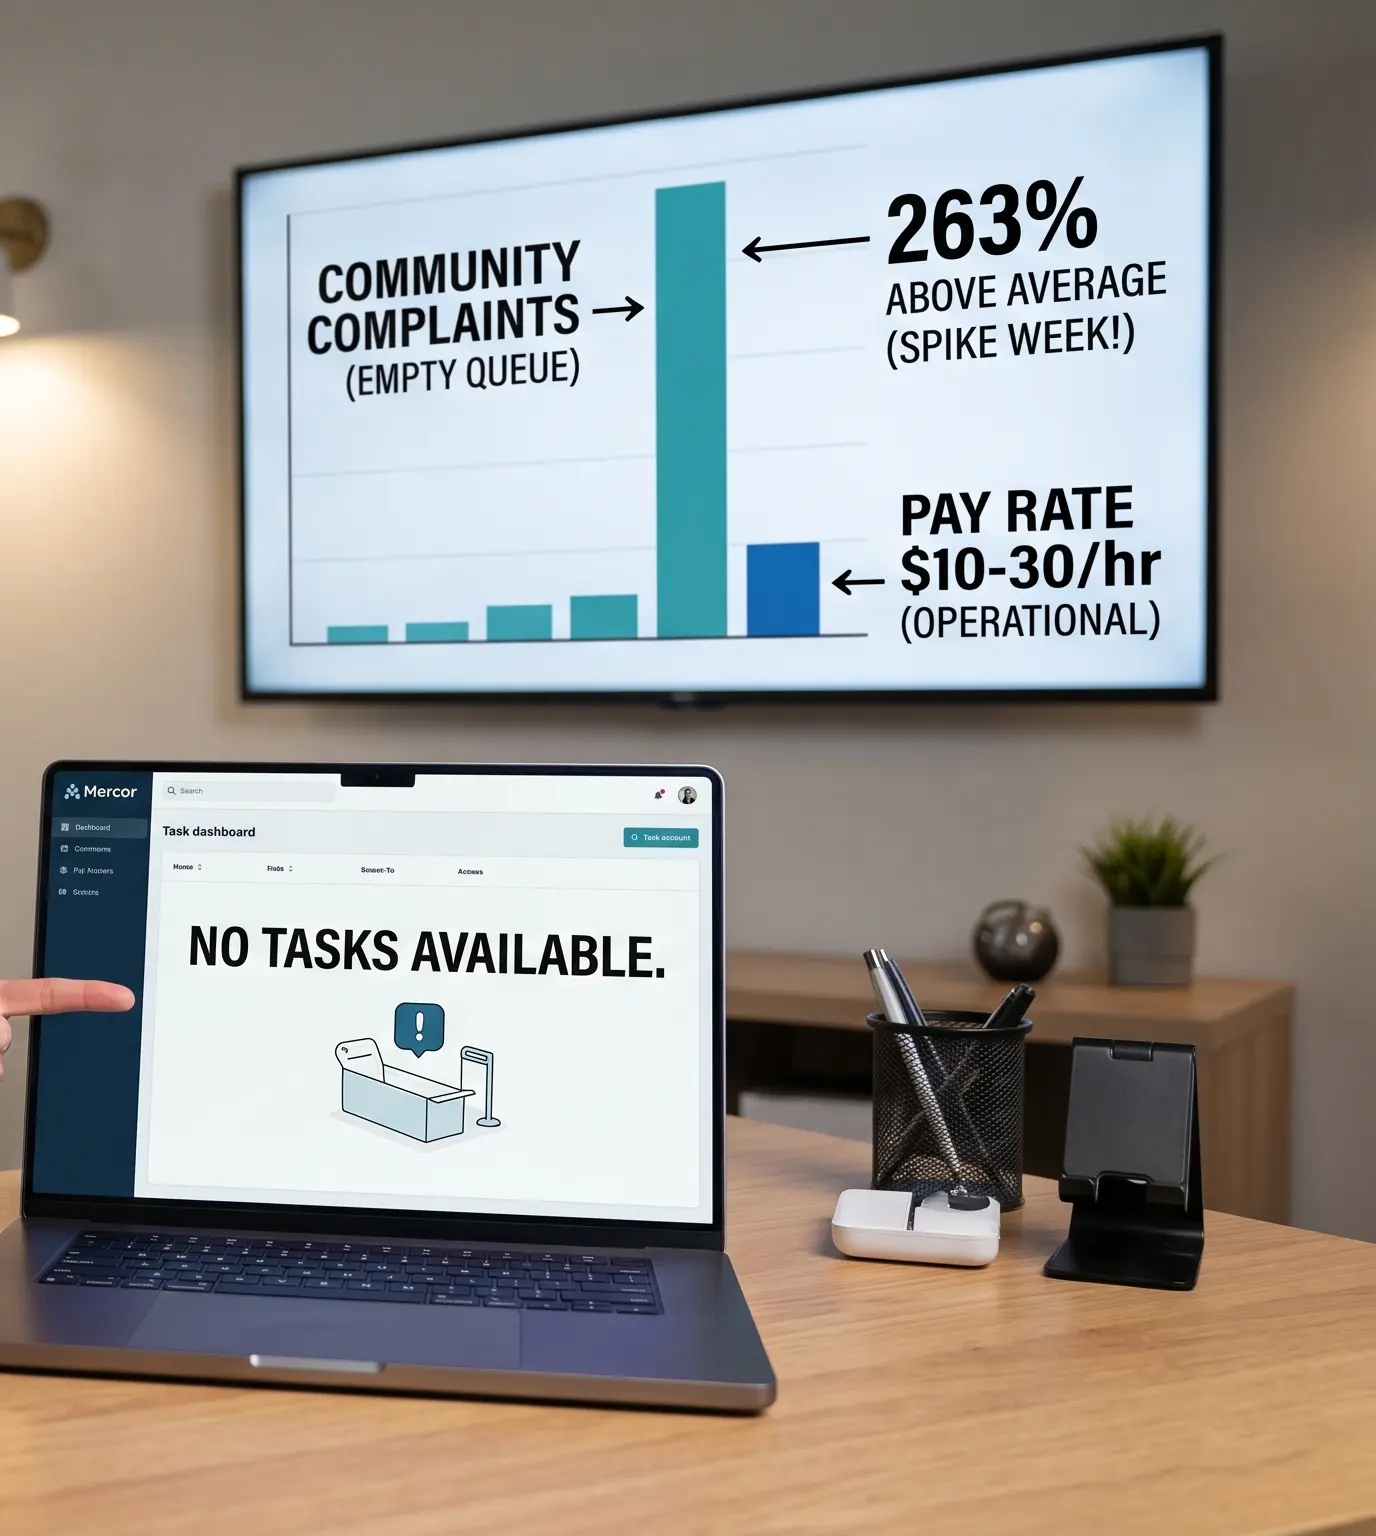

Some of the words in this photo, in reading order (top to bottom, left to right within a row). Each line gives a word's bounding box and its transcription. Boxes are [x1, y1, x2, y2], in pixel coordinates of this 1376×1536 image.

[887, 176, 1099, 265] 263%
[318, 240, 581, 304] COMMUNITY
[885, 275, 997, 316] ABOVE
[1006, 261, 1167, 307] AVERAGE
[307, 293, 580, 354] COMPLAINTS
[887, 324, 998, 371] (SPIKE
[1008, 312, 1135, 356] WEEK!)
[346, 358, 457, 403] (EMPTY
[466, 347, 580, 390] QUEUE)
[902, 490, 992, 536] PAY
[1007, 484, 1134, 533] RATE
[900, 540, 1162, 597] $10-30/hr
[901, 599, 1160, 645] (OPERATIONAL)
[84, 785, 138, 798] Mercor
[180, 787, 203, 795] Search
[162, 825, 190, 837] Task
[192, 826, 256, 838] dashboard
[189, 925, 249, 968] NO
[261, 927, 399, 971] TASKS
[410, 931, 665, 979] AVAILABLE.
